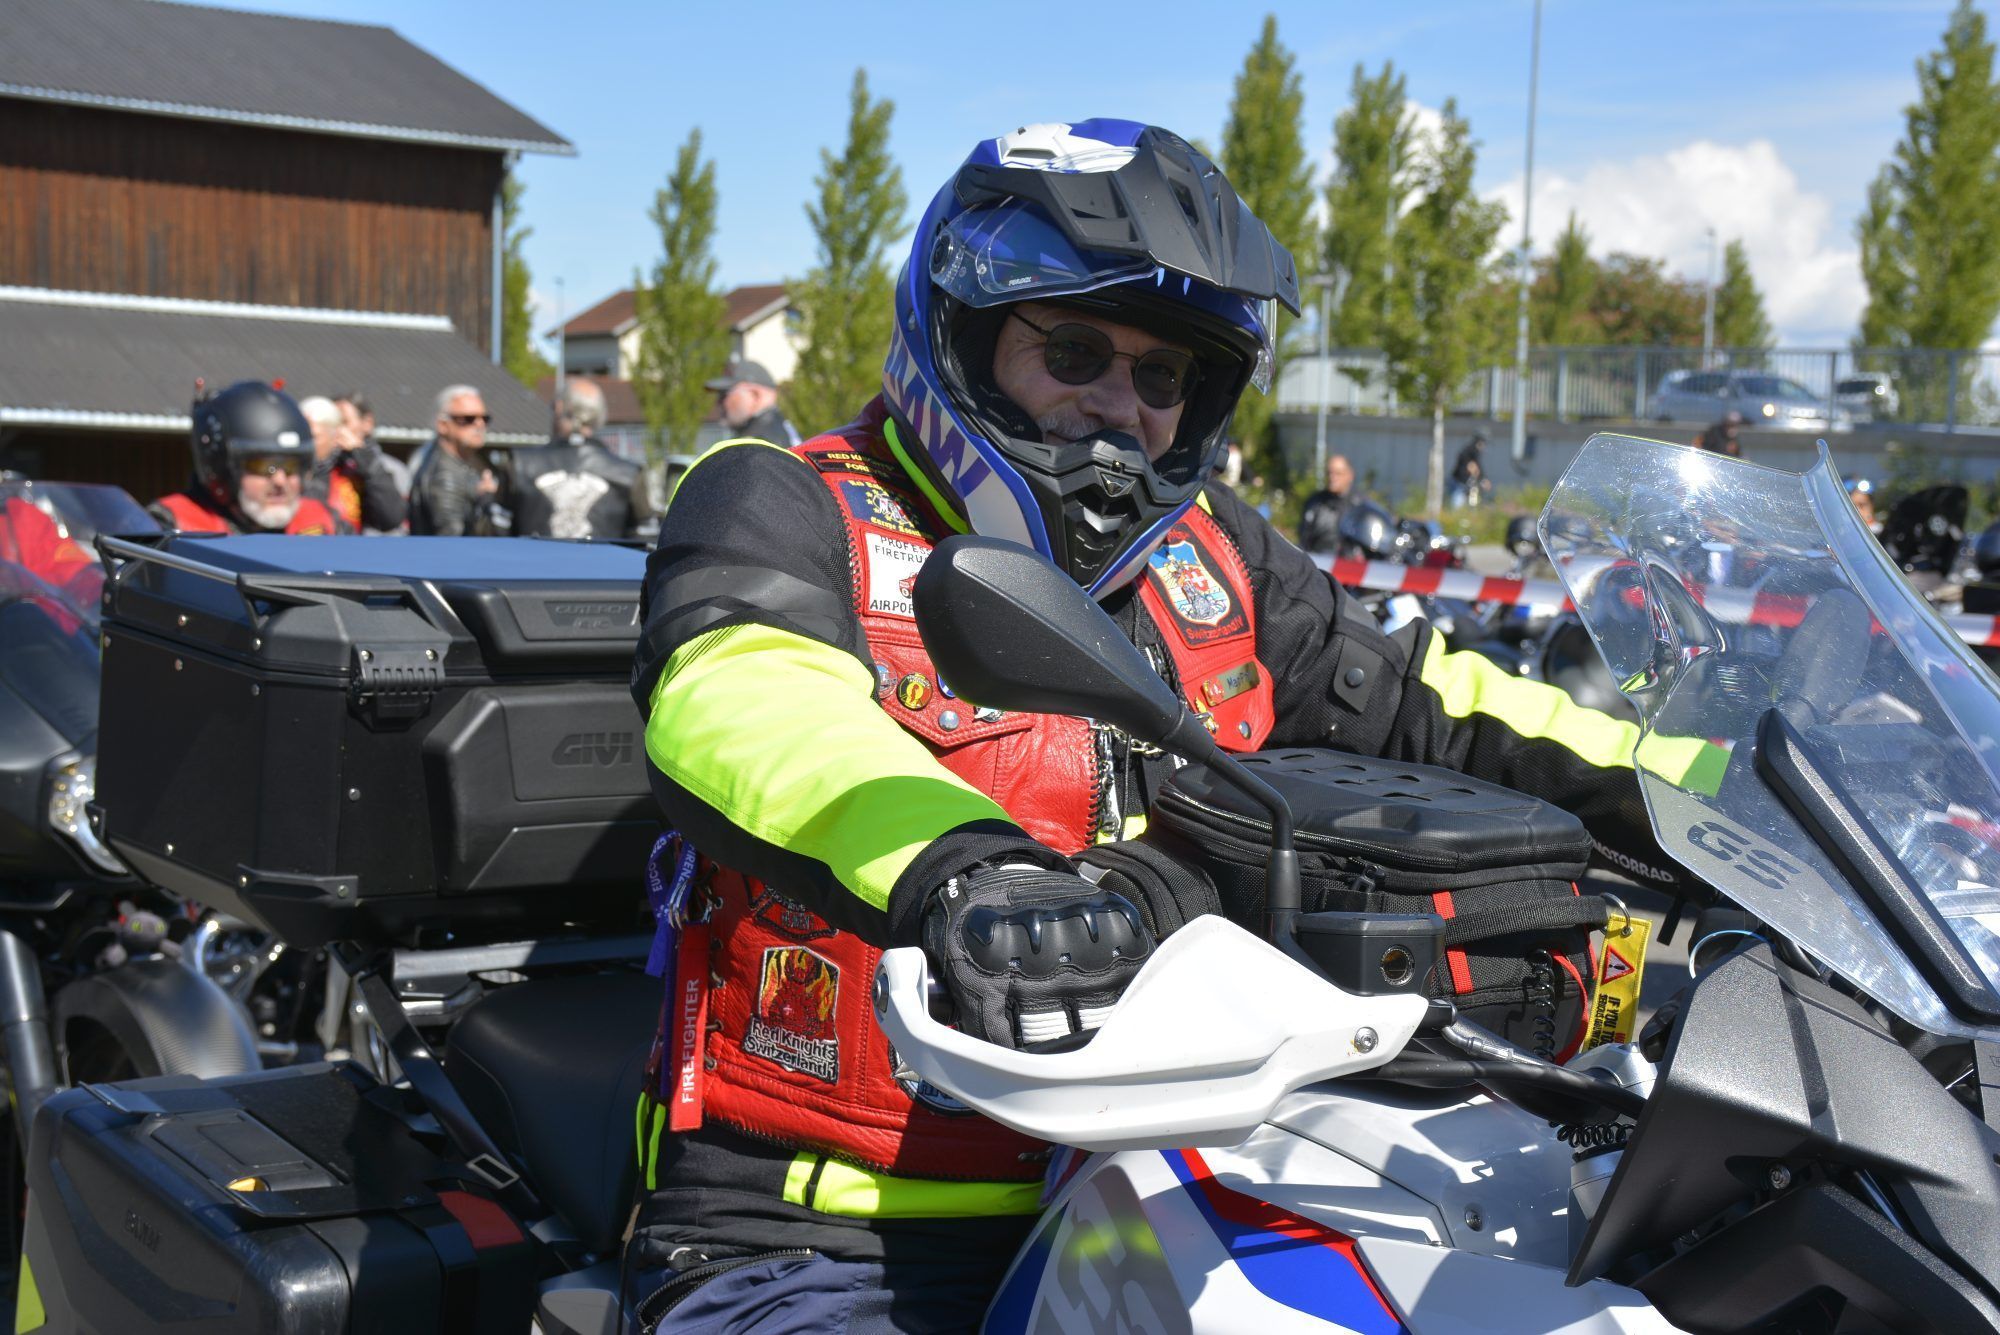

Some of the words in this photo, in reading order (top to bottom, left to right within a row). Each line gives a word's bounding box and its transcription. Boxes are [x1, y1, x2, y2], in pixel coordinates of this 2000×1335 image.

[552, 732, 633, 768] GIVI
[1687, 821, 1801, 890] GS
[1603, 1009, 1619, 1028] YOU
[1608, 996, 1621, 1007] IF
[682, 978, 699, 1104] FIREFIGHTER
[744, 1034, 828, 1078] Switzerland
[752, 1018, 780, 1043] Red
[781, 1028, 837, 1062] Knights
